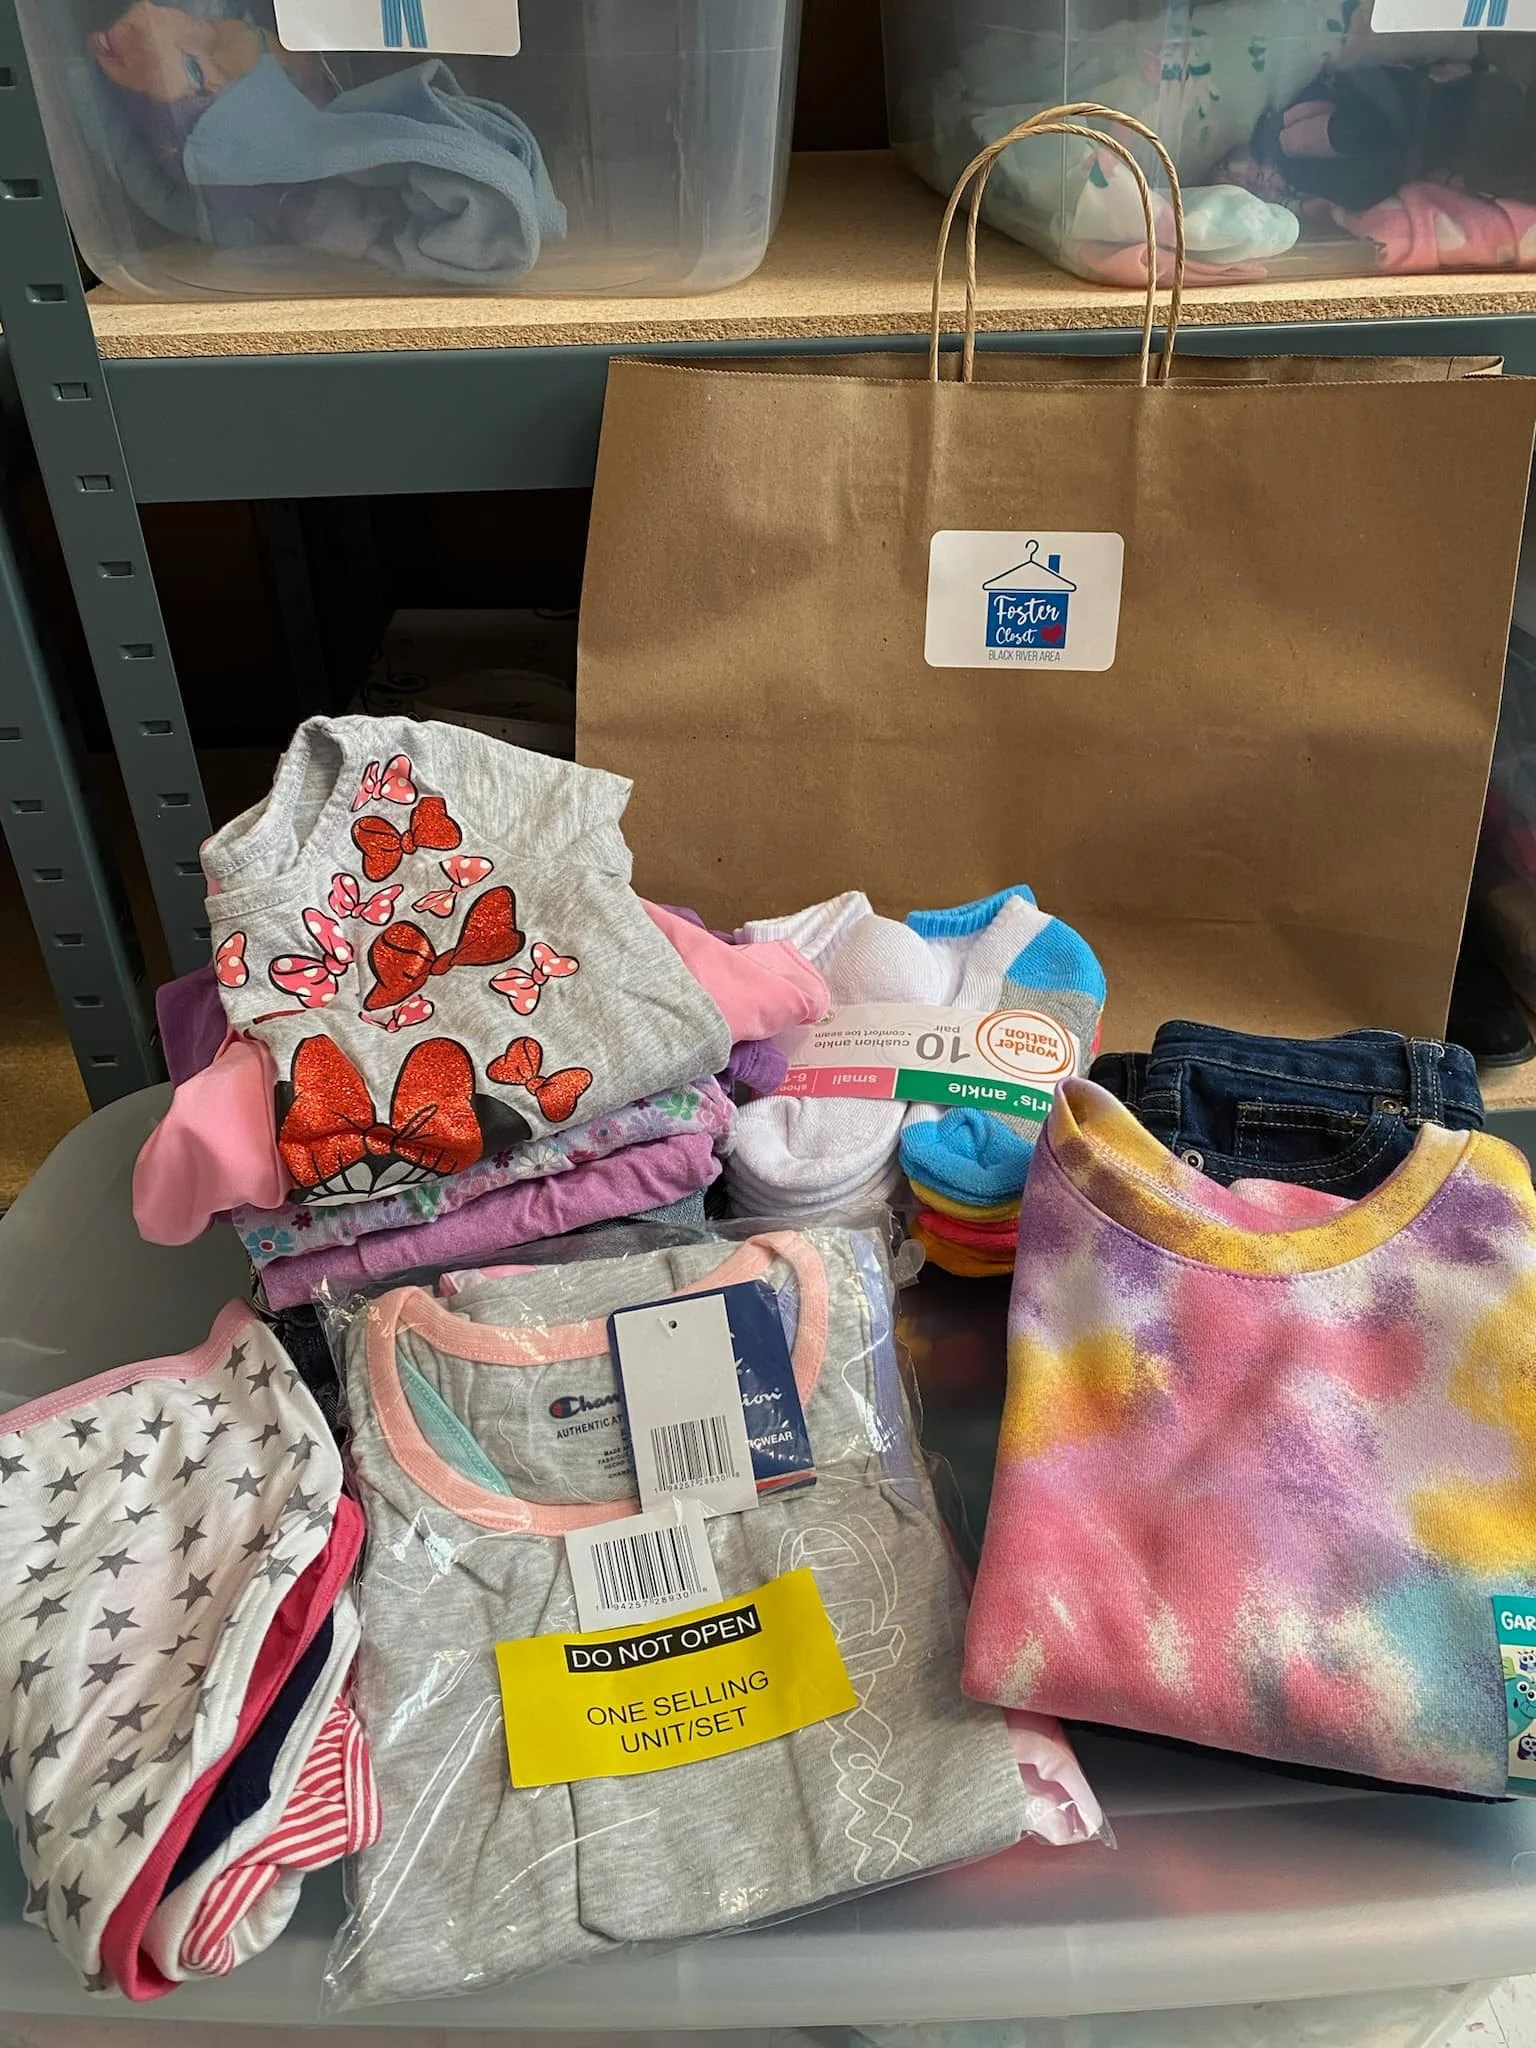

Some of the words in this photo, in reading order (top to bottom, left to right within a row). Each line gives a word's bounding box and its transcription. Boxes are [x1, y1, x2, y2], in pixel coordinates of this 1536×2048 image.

[993, 595, 1061, 625] Foster
[995, 627, 1038, 645] Closet
[988, 649, 1013, 661] BLACK
[1016, 650, 1038, 662] RIVER
[1039, 651, 1061, 662] AREA
[864, 1029, 905, 1037] comfort
[933, 1024, 961, 1034] pair
[1004, 1028, 1058, 1048] nation
[814, 1039, 851, 1049] ankle
[855, 1039, 910, 1048] cushion
[916, 1033, 971, 1063] 10
[995, 1039, 1059, 1061] wonder
[784, 1072, 807, 1083] 6-1
[832, 1074, 878, 1085] small
[948, 1082, 1007, 1100] ankle
[1013, 1094, 1053, 1113] irls'
[742, 1391, 782, 1407] ion
[556, 1418, 610, 1440] AUTHENTIC
[611, 1414, 623, 1424] AT
[750, 1431, 793, 1448] ICWEAR
[1500, 1610, 1536, 1631] GAR
[571, 1647, 612, 1669] DO
[618, 1635, 673, 1665] NOT
[680, 1612, 758, 1648] OPEN
[586, 1700, 646, 1726] ONE
[654, 1670, 769, 1717] SELLING
[621, 1706, 748, 1754] UNIT/SET
